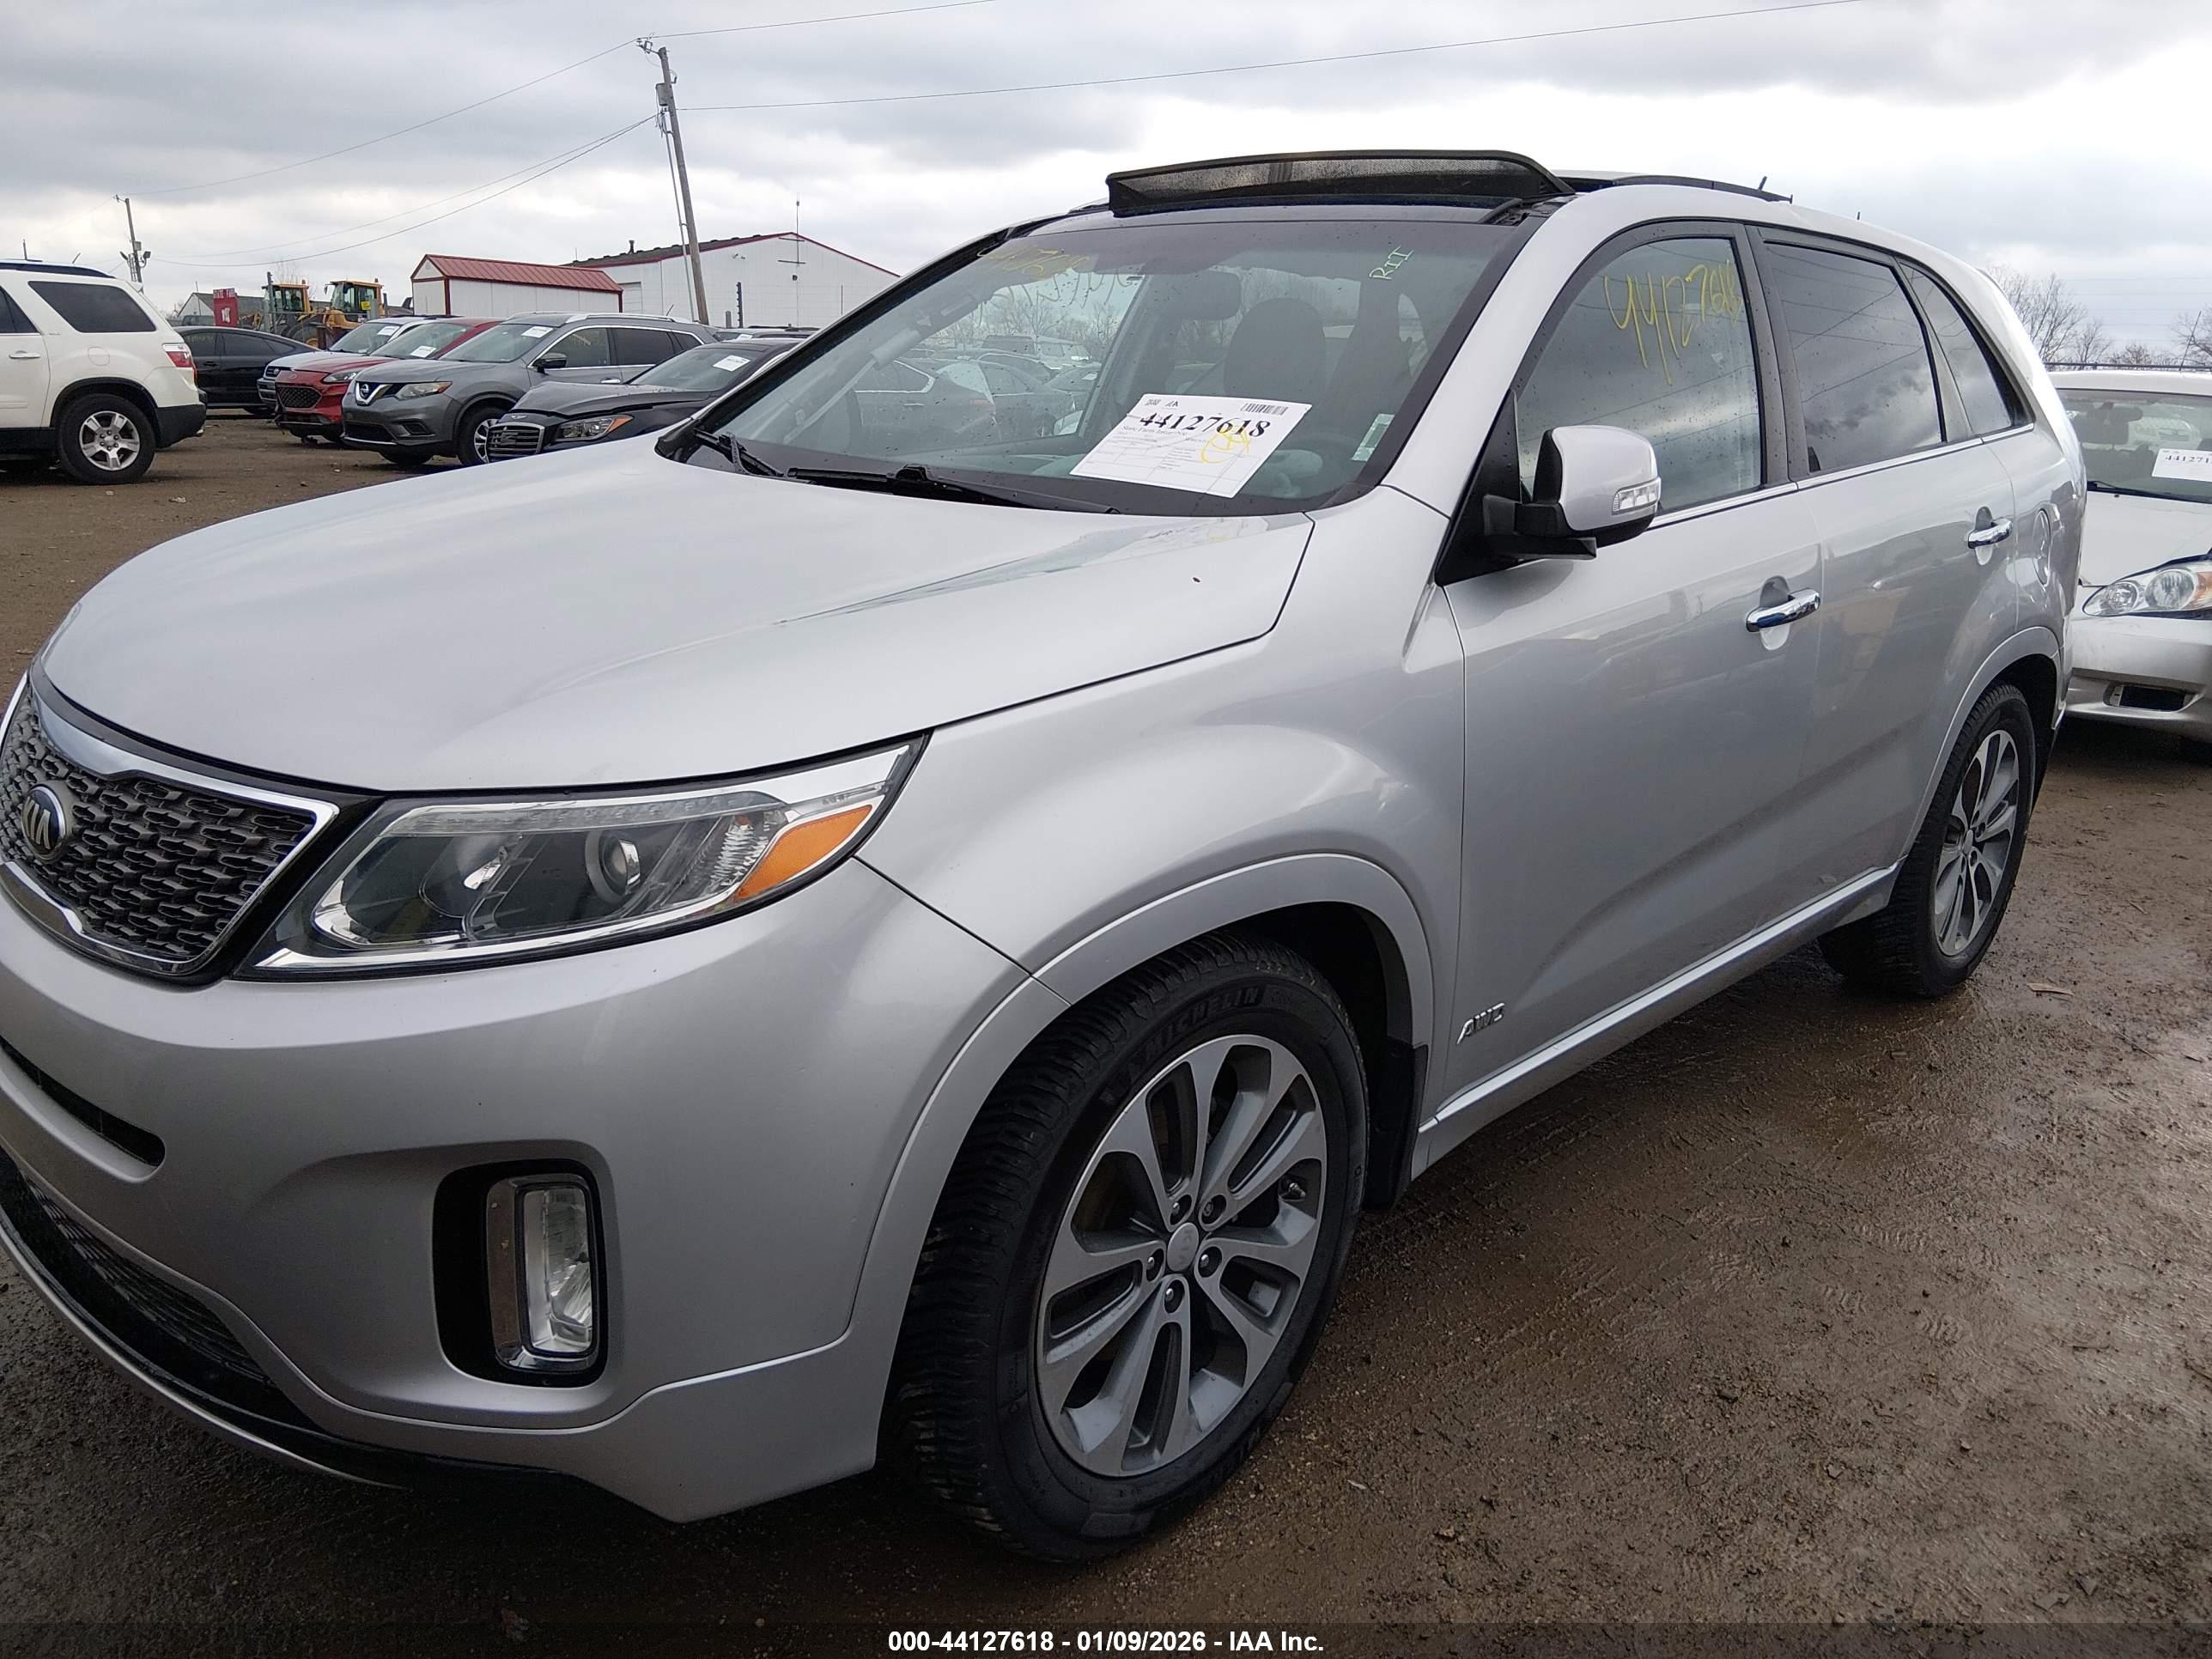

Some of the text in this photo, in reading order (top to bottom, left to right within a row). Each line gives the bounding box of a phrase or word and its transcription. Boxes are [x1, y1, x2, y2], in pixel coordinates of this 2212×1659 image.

[1140, 412, 1271, 438] 44127618
[2165, 454, 2212, 465] 441271
[1145, 986, 1260, 1063] MICHELIN
[1456, 1001, 1505, 1045] AWD
